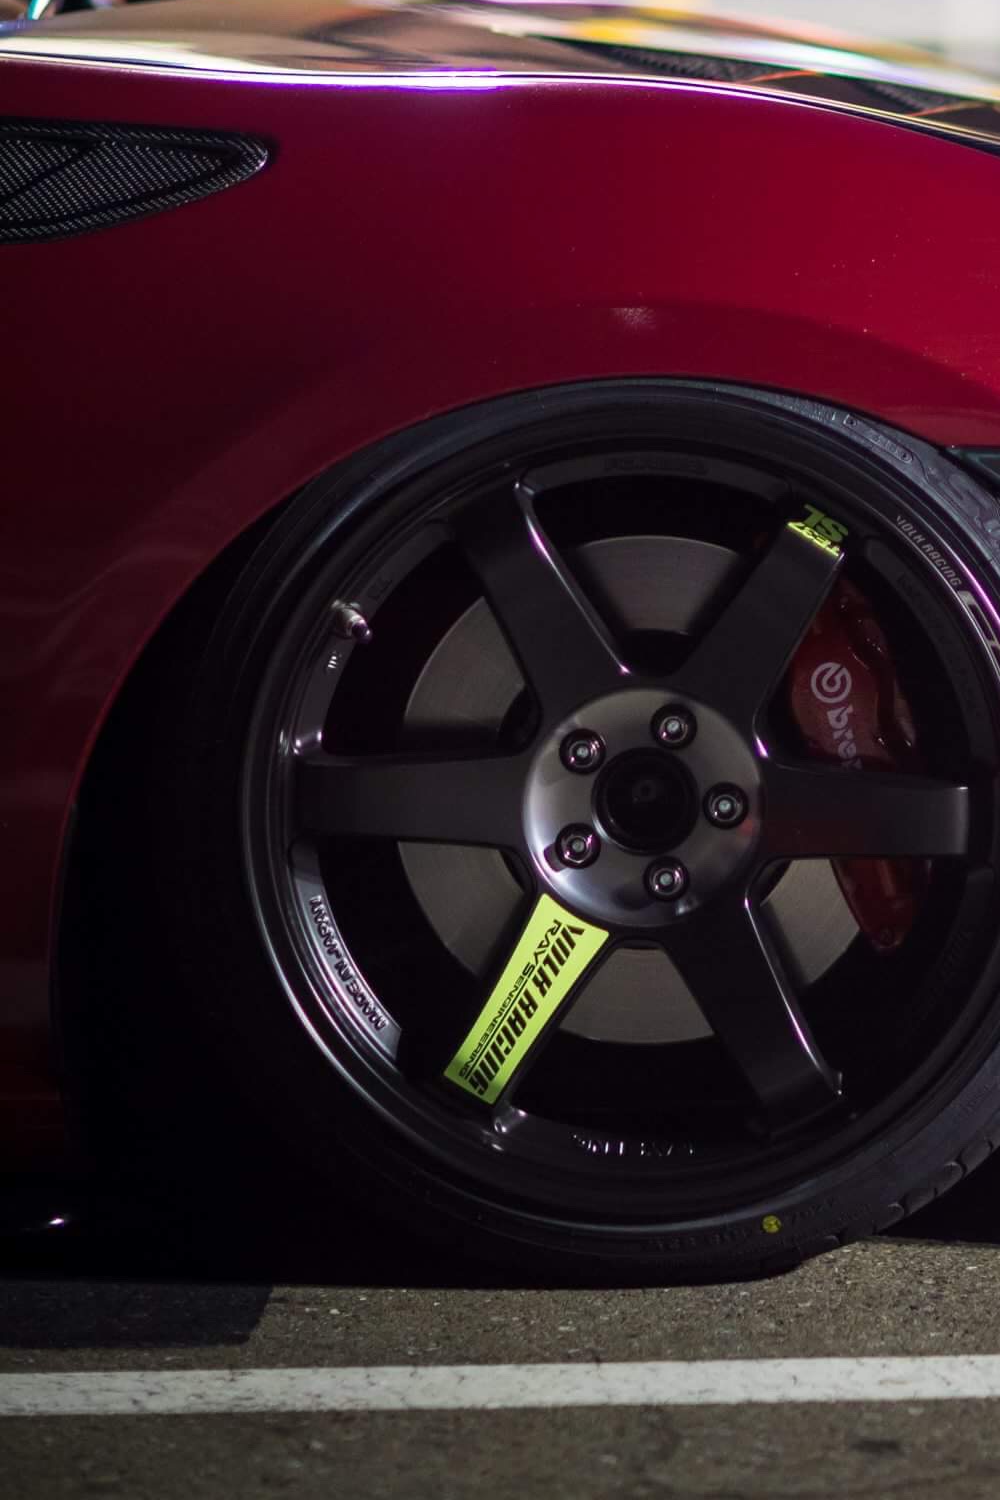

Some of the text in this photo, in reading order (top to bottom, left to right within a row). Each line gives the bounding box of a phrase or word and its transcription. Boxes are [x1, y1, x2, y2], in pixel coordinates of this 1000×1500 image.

[787, 520, 841, 557] TE37
[804, 503, 849, 544] SL
[896, 514, 926, 549] VOLK
[923, 542, 963, 588] RACING
[309, 894, 389, 1032] MADE IN JAPAN
[468, 923, 585, 1096] VOLK RACING
